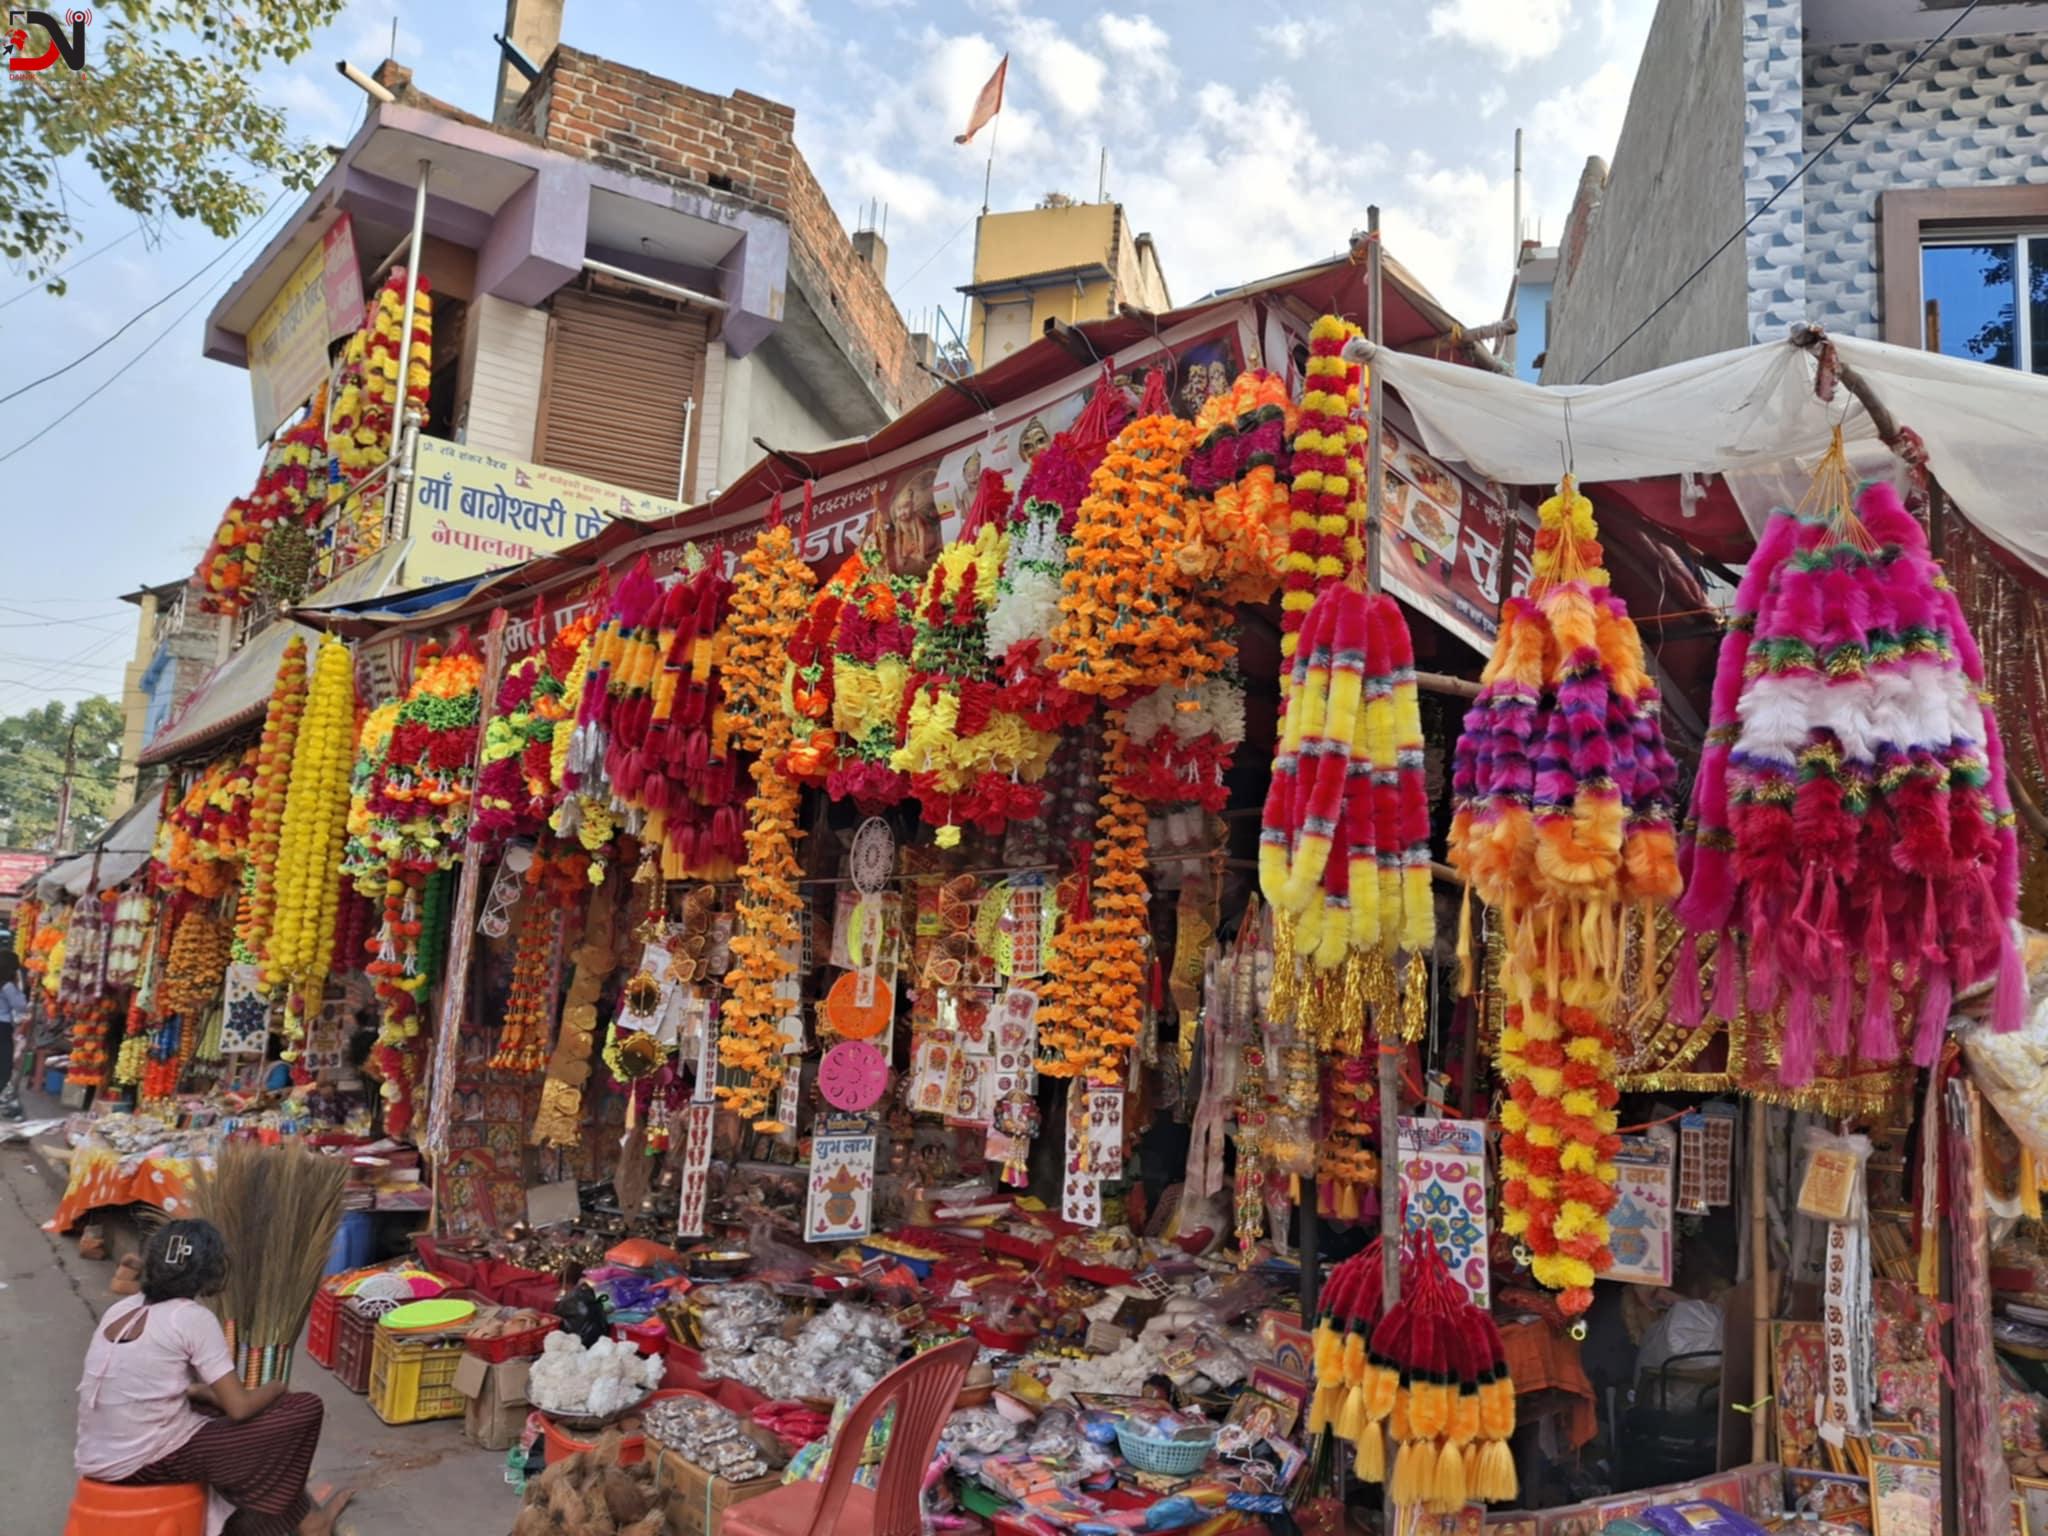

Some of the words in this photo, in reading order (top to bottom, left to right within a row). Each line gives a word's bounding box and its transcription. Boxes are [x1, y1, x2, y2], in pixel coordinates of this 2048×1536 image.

[460, 483, 567, 538] बागेश्वरी
[815, 1139, 841, 1160] शुभ
[843, 1138, 873, 1154] लाभ
